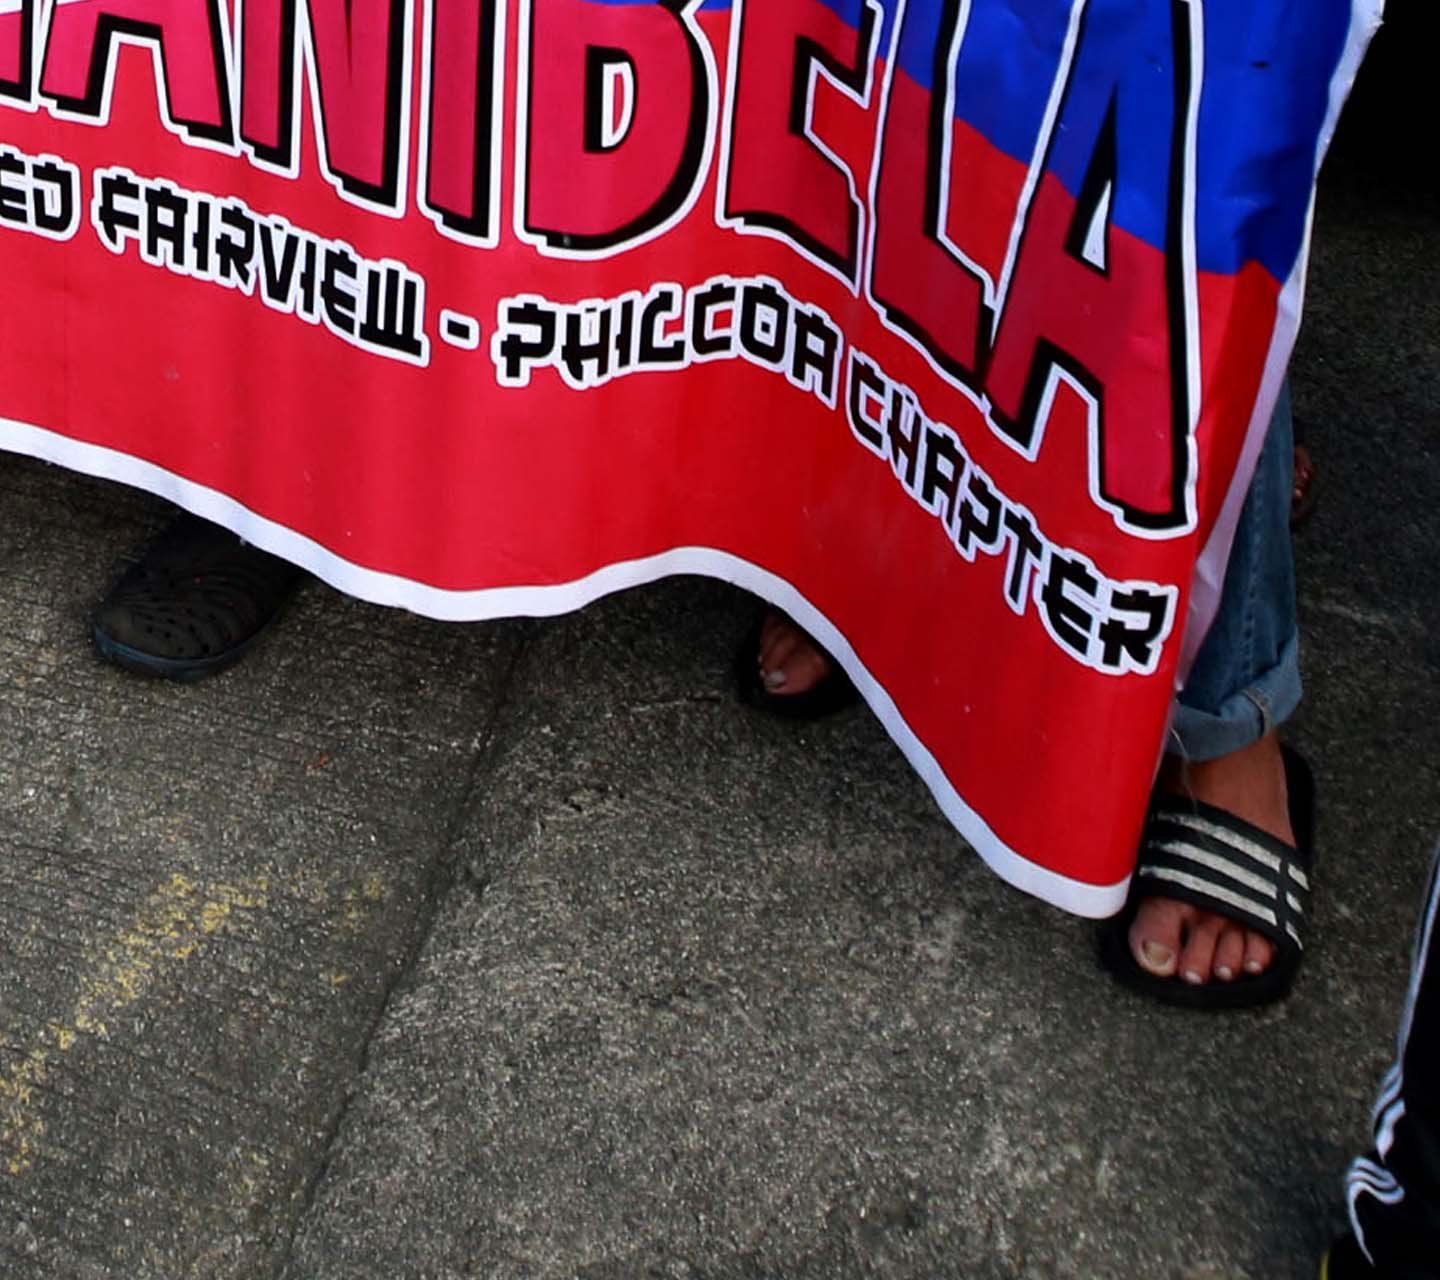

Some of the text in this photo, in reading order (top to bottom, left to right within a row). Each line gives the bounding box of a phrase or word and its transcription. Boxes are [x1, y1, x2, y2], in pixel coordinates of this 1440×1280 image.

[99, 178, 424, 360] FAIRVIEW
[496, 278, 842, 410] PHILCOA
[849, 354, 1175, 670] CHAPTER
